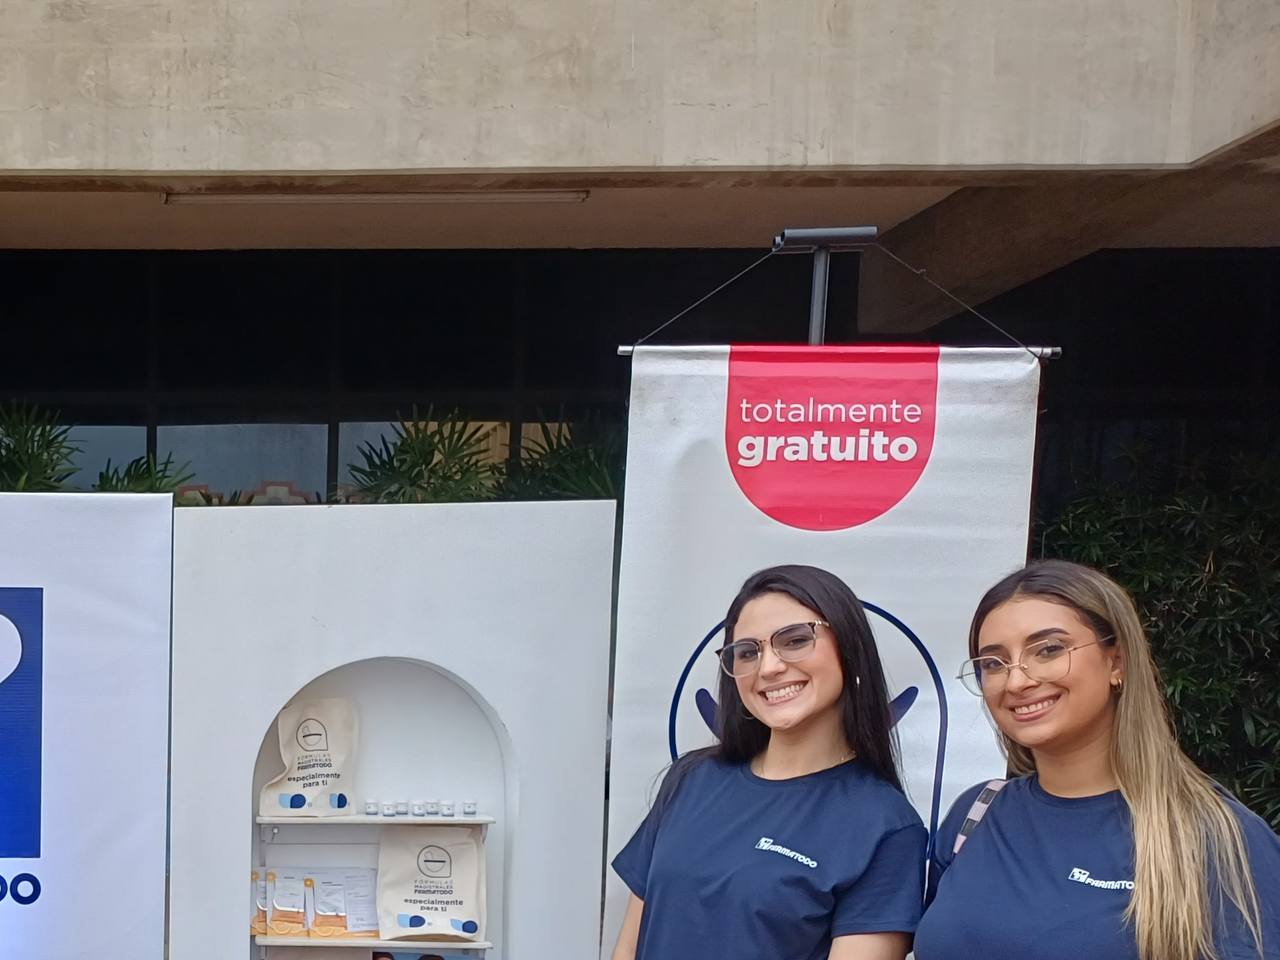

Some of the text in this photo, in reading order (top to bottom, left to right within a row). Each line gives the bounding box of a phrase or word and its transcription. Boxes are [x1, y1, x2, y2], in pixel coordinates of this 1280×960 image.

[740, 396, 923, 424] totalmente
[736, 428, 919, 468] gratuito
[287, 772, 341, 783] especialmente
[302, 781, 320, 789] para
[1085, 877, 1136, 890] FARMATO
[403, 898, 464, 907] especialmente
